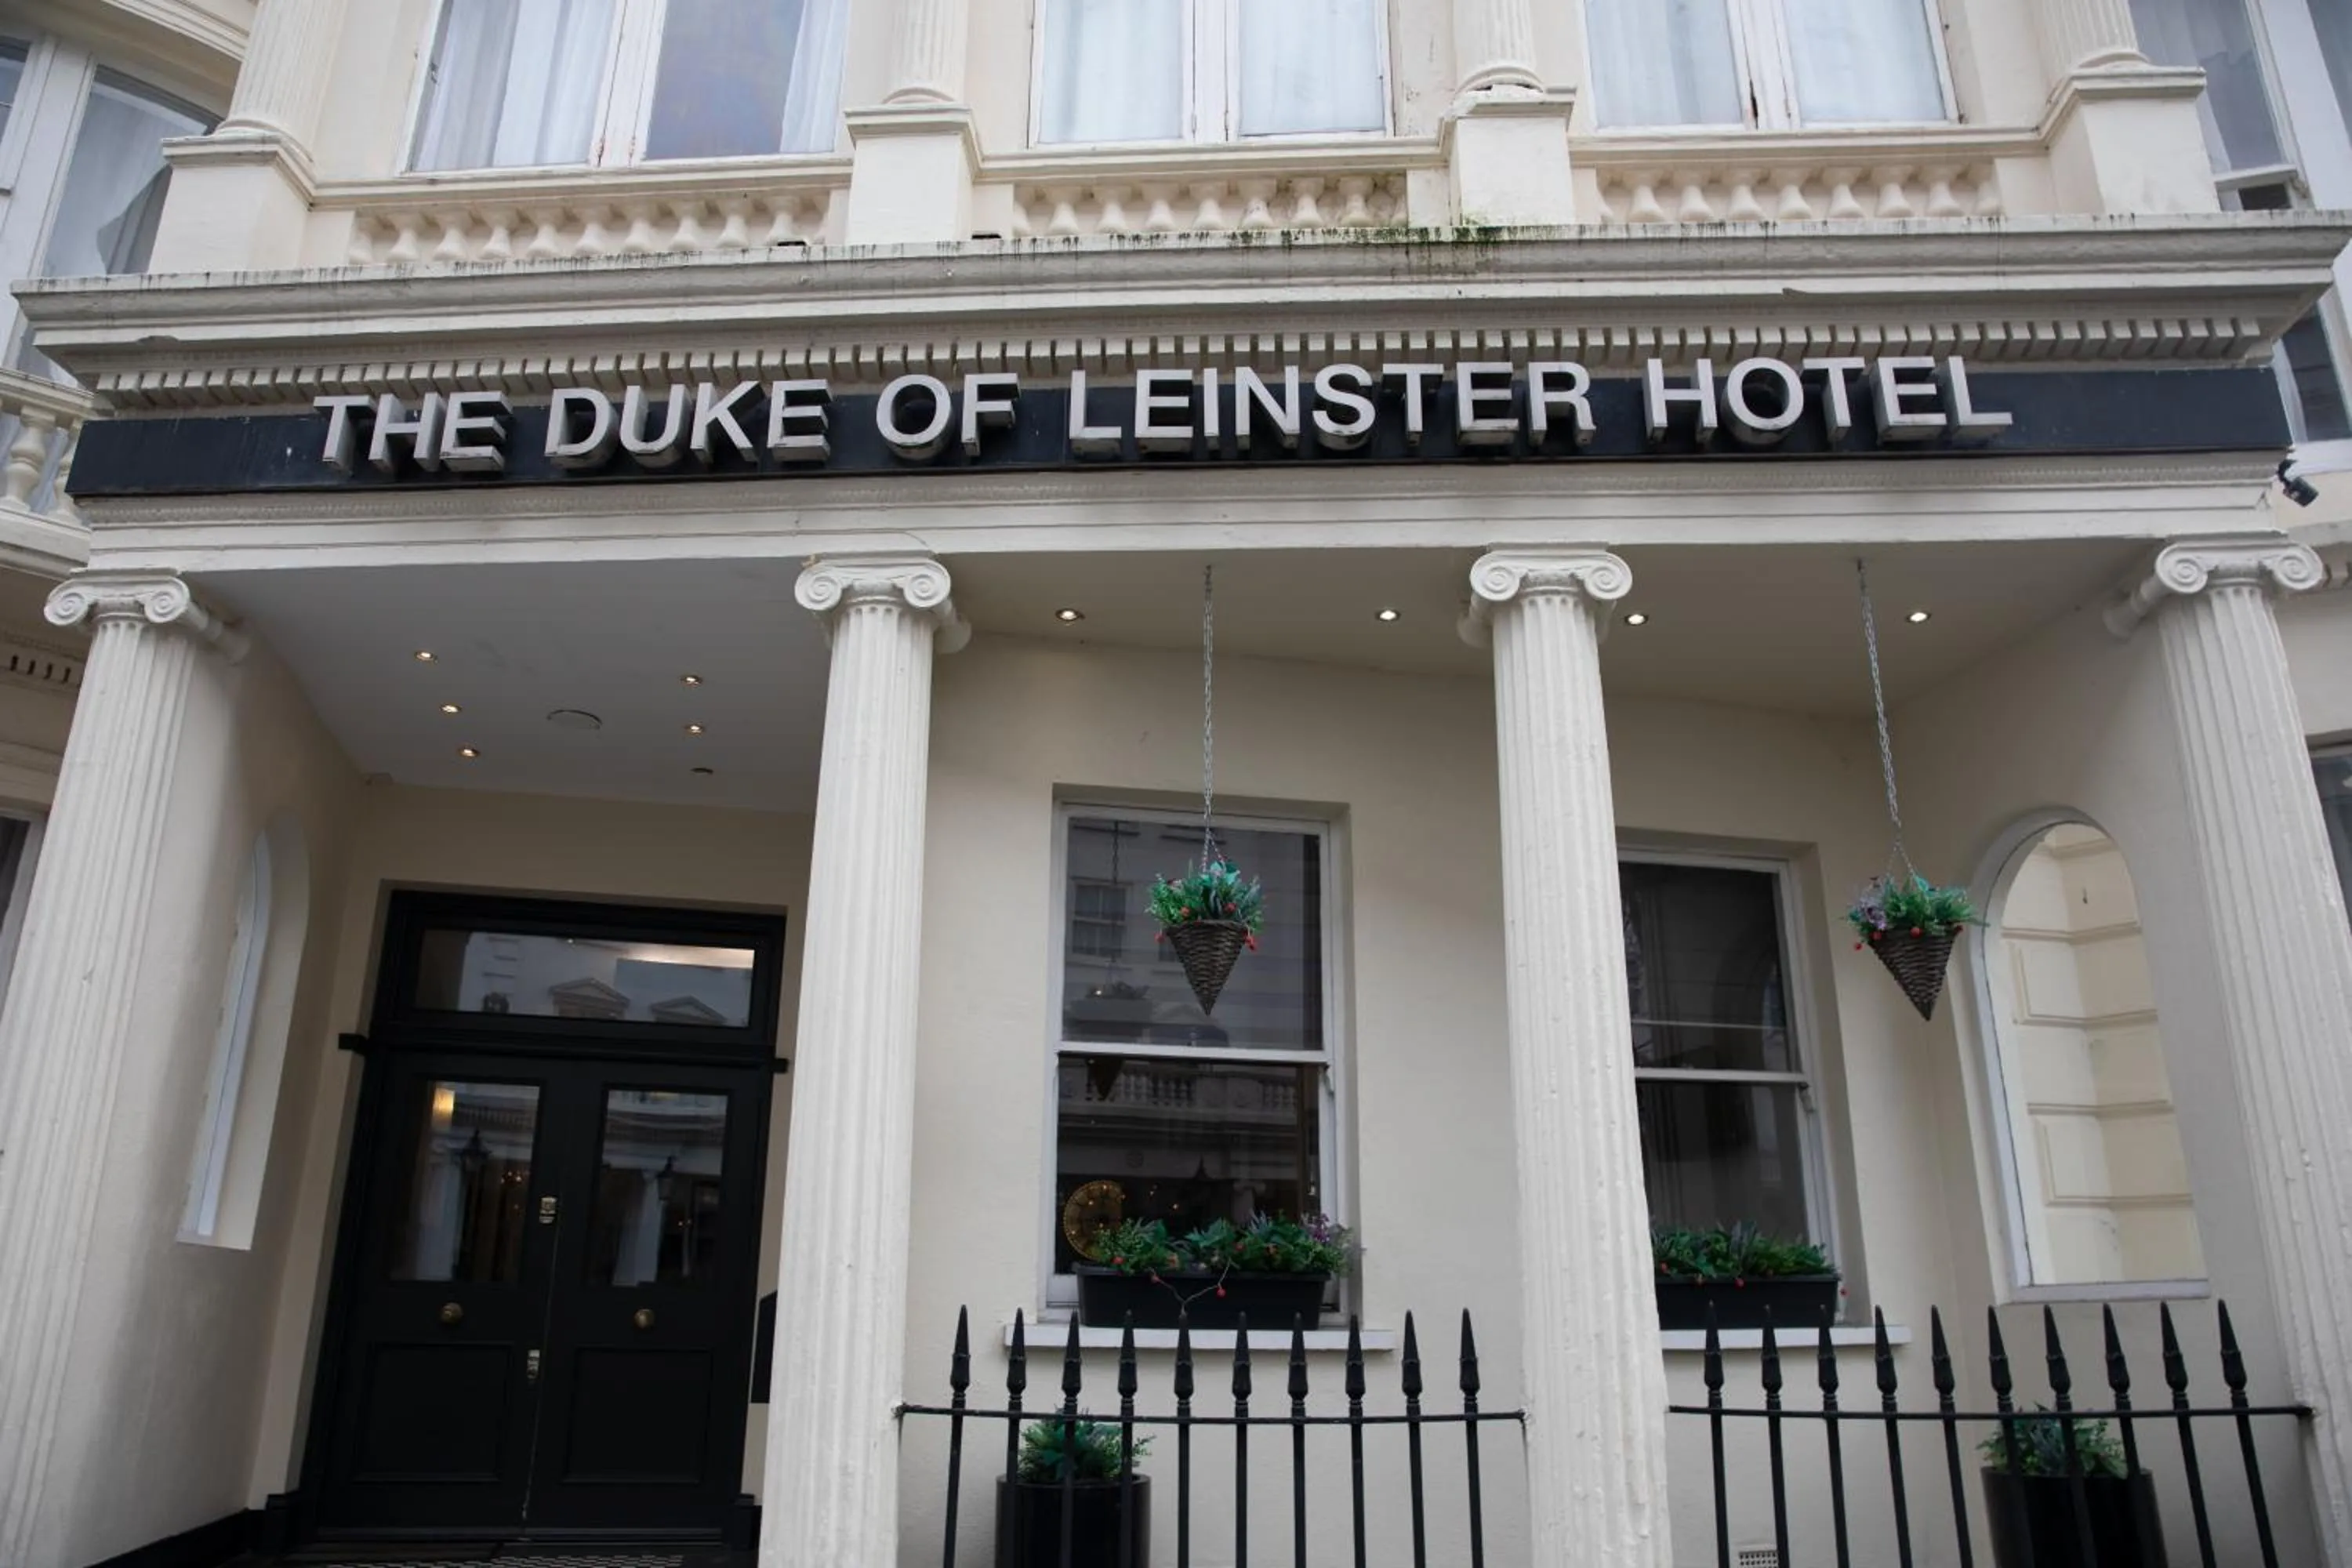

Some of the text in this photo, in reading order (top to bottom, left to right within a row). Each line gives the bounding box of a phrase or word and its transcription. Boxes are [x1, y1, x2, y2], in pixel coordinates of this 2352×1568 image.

[314, 356, 2013, 469] THE DUKE OF LEINSTER HOTEL
